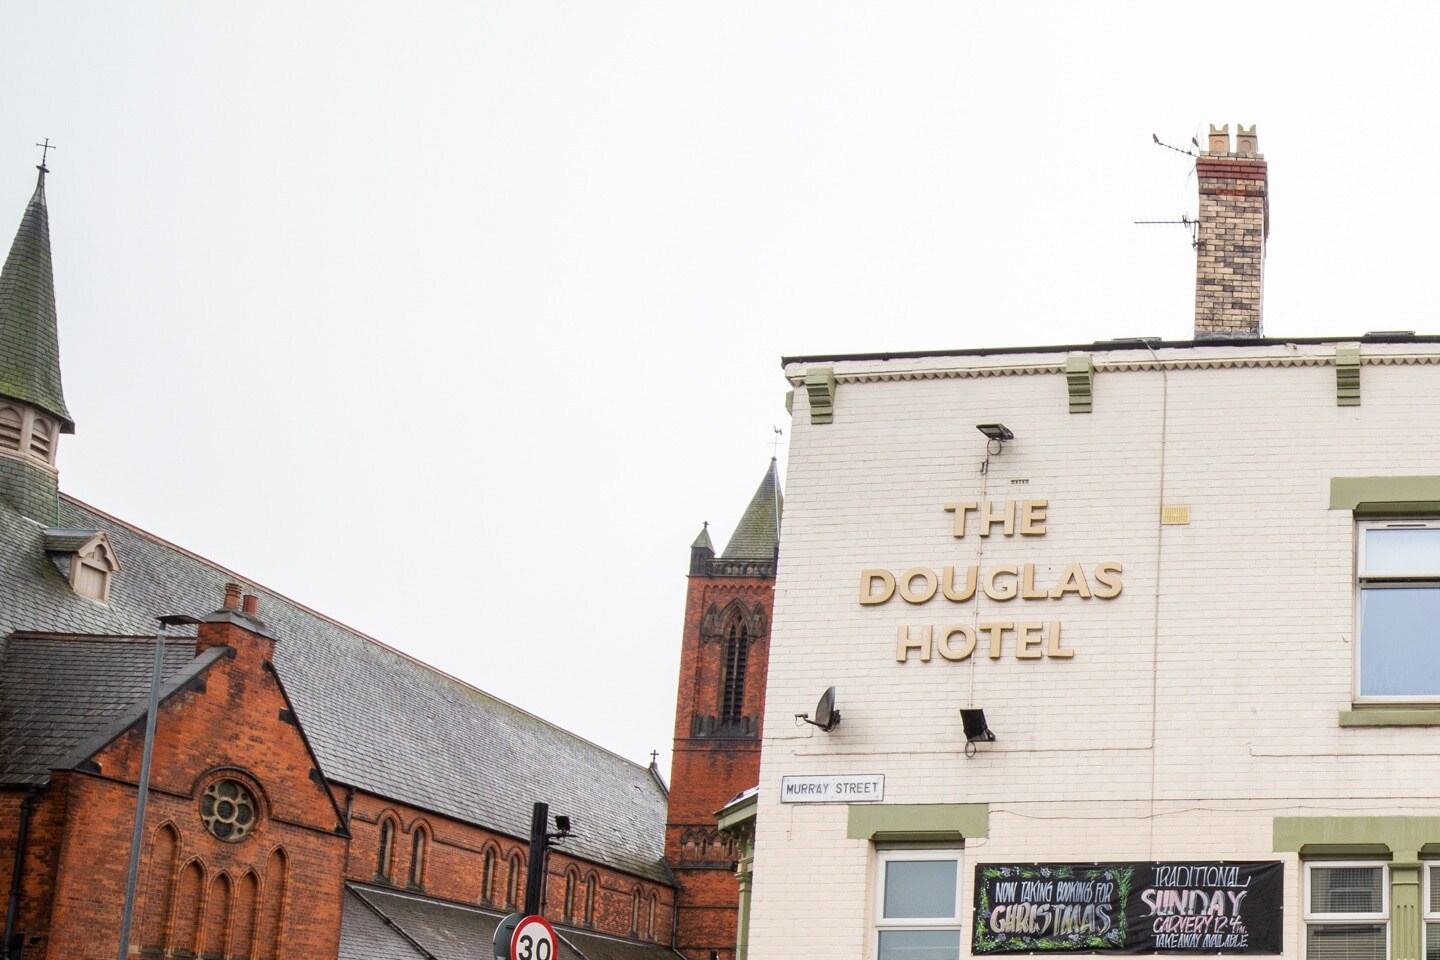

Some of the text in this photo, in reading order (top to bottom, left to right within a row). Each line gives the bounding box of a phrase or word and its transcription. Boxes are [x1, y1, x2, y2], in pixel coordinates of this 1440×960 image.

[944, 500, 1048, 538] THE
[859, 562, 1124, 606] DOUGLAS
[896, 620, 1075, 663] HOTEL
[786, 782, 879, 795] MURRAY STREET
[995, 880, 1114, 903] NOW TAKING BOOKINGS FOR
[1151, 866, 1252, 888] TRADITIONAL
[1140, 888, 1248, 918] SUNDAY
[989, 902, 1113, 937] CHRISTMAS
[1152, 915, 1214, 934] CARVERY
